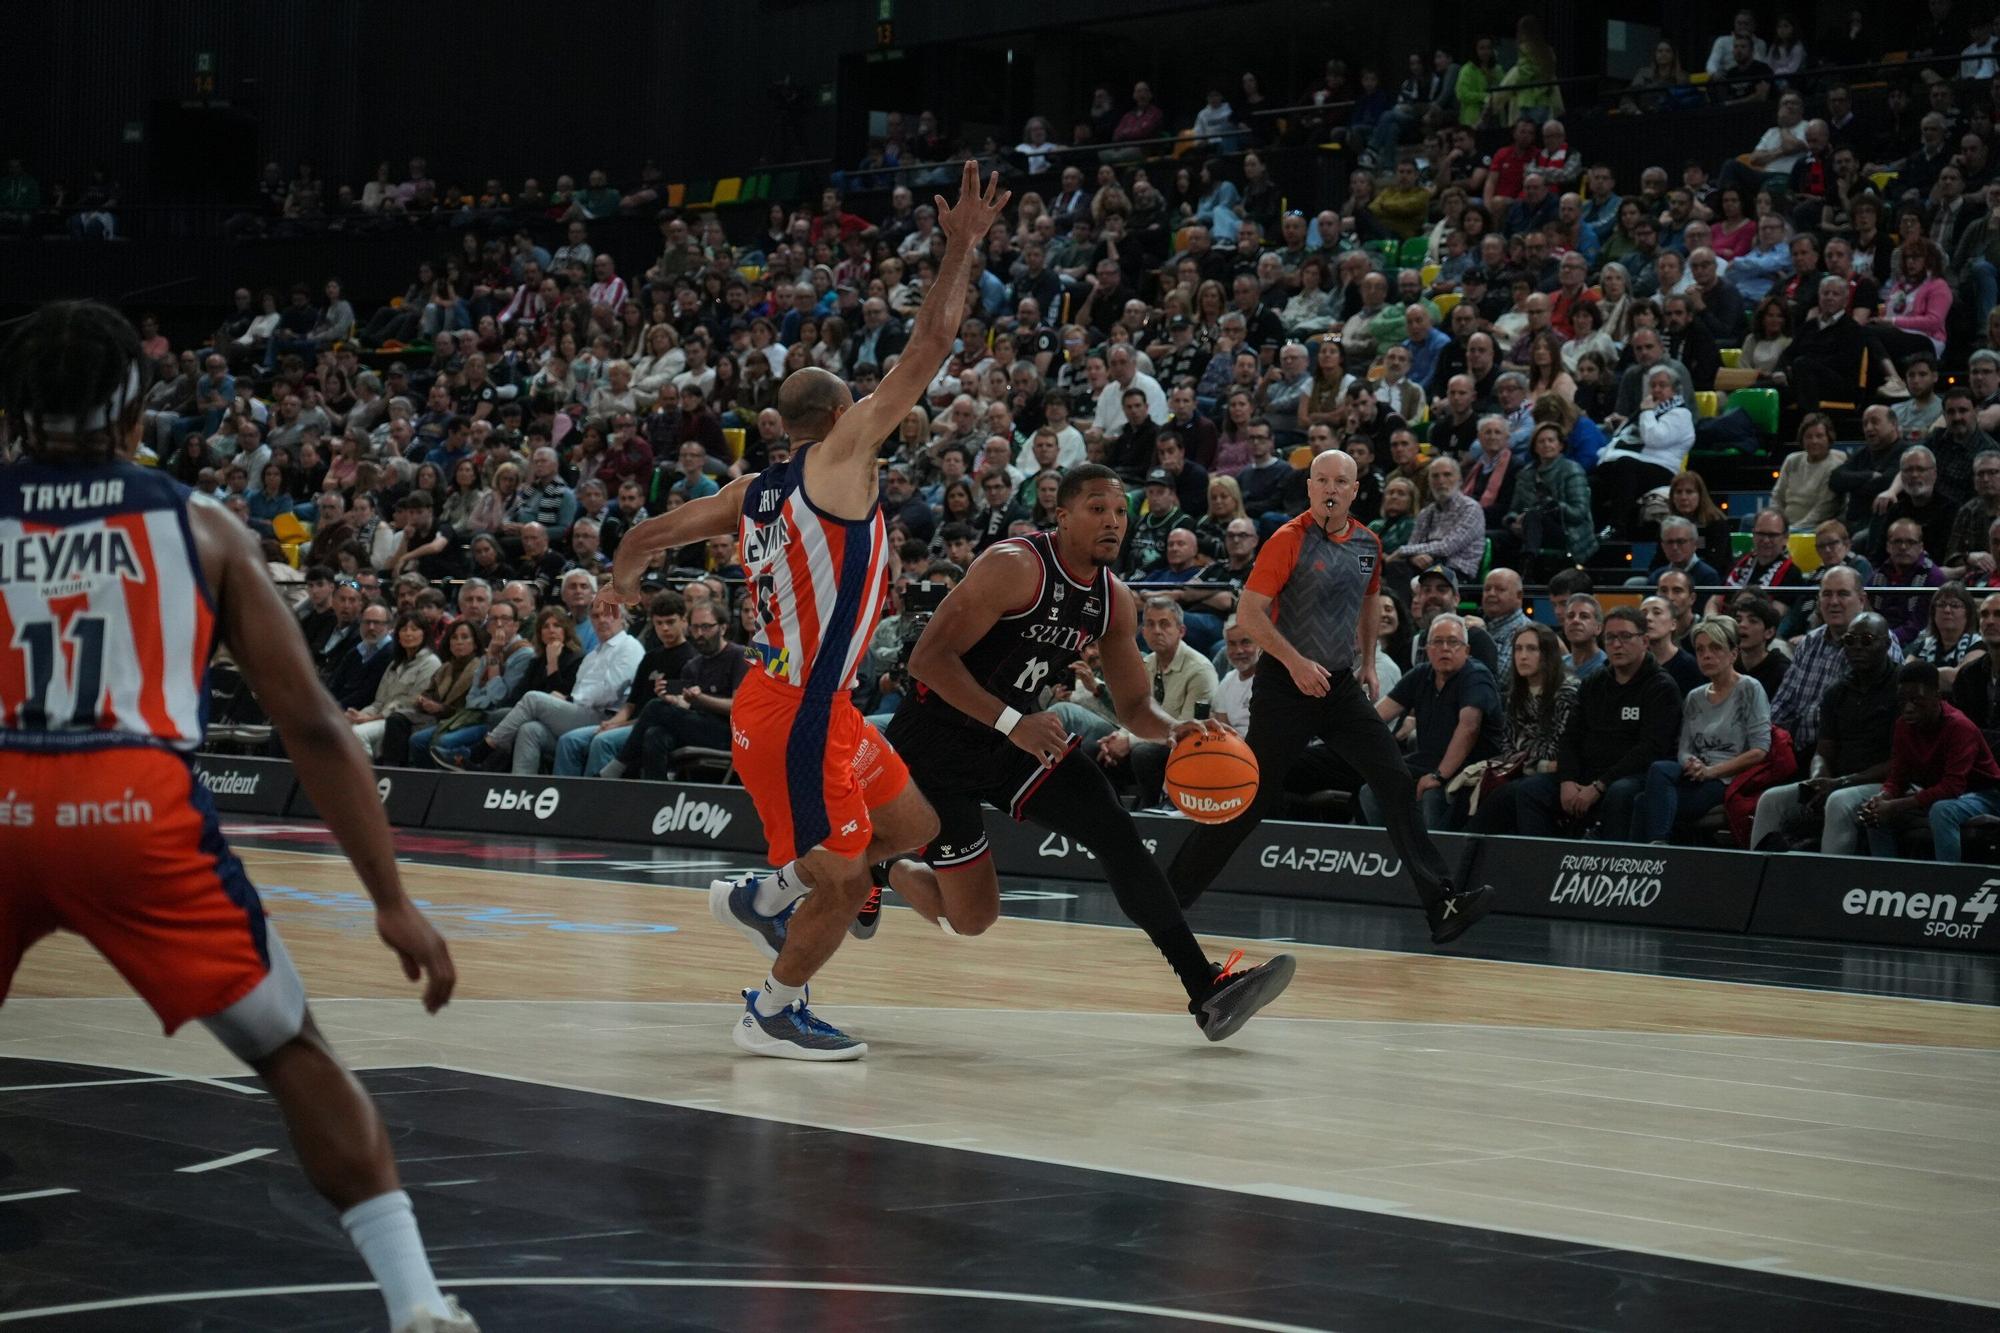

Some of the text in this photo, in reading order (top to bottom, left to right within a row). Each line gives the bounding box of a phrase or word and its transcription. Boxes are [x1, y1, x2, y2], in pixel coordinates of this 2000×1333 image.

[20, 478, 125, 513] TAYLOR
[0, 532, 139, 584] LEYMA
[19, 618, 105, 730] 11
[198, 770, 259, 795] Occident
[483, 788, 534, 811] bbk
[55, 783, 153, 828] ancín
[652, 792, 732, 839] elrow
[1178, 791, 1242, 812] Wilson
[1260, 845, 1403, 878] GARBINDU
[1560, 854, 1667, 875] FRUTAS Y VERDURAS
[1549, 871, 1662, 908] LANDAKO
[1923, 921, 1982, 939] SPORT
